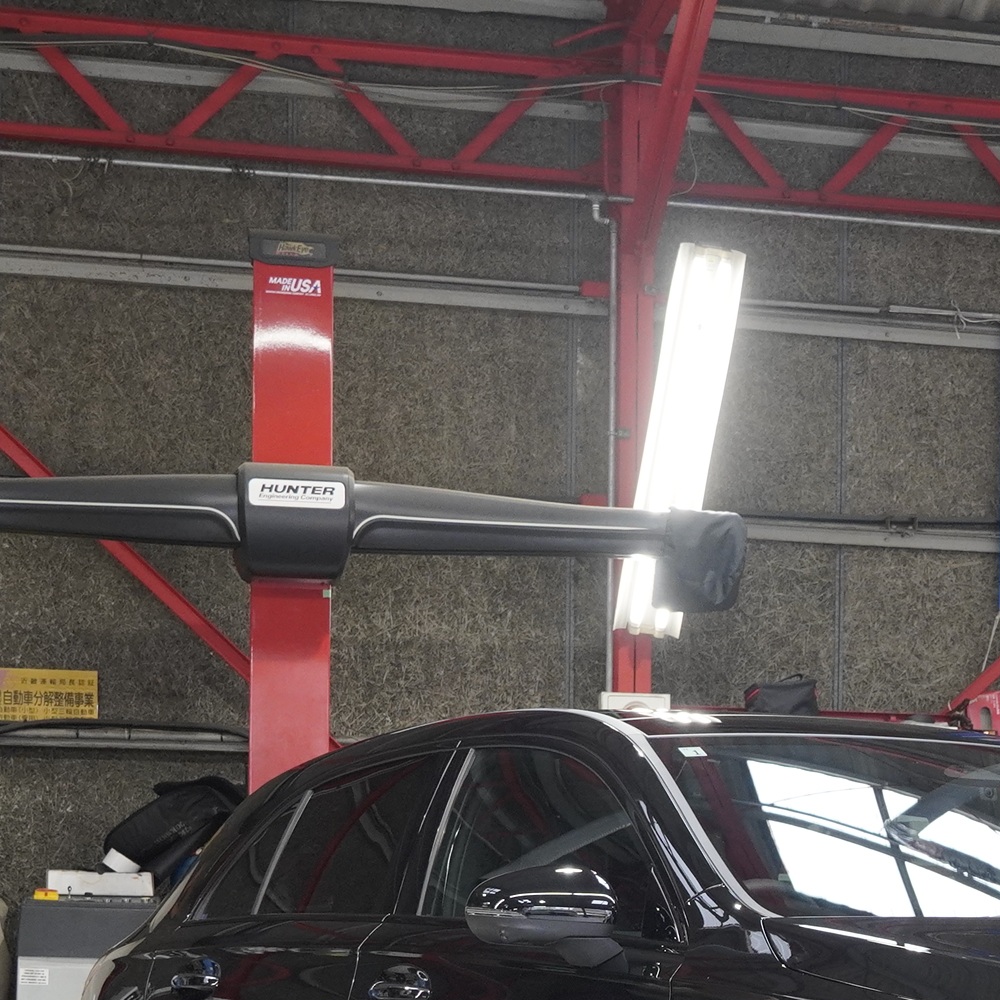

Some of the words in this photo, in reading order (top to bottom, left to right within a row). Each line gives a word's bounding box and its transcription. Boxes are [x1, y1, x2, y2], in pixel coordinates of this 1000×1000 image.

[268, 276, 292, 285] MADE
[281, 284, 291, 292] IN
[291, 278, 322, 294] USA
[260, 484, 336, 495] HUNTER
